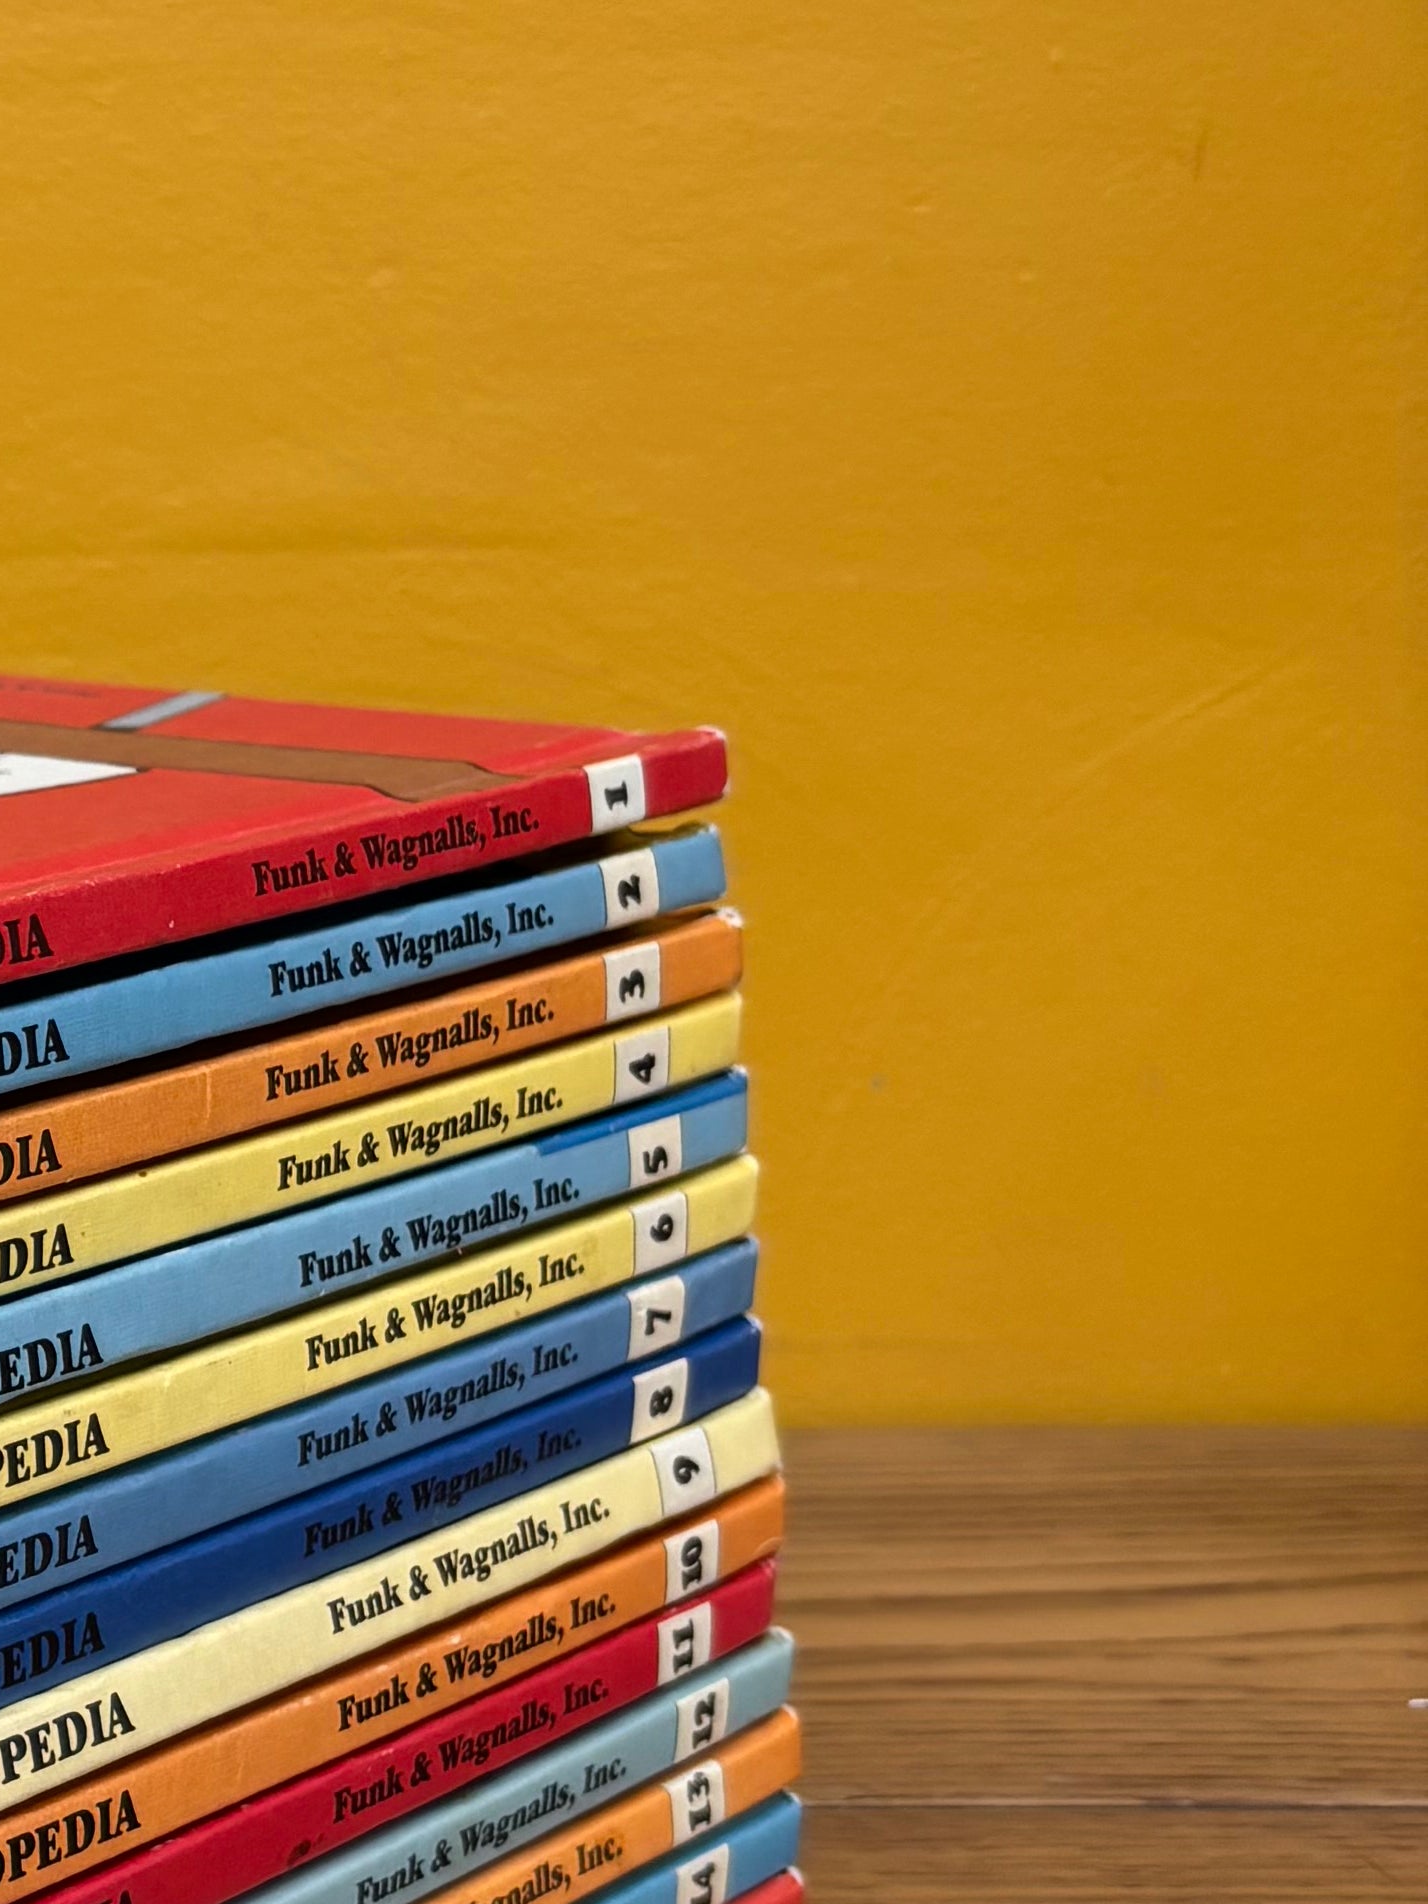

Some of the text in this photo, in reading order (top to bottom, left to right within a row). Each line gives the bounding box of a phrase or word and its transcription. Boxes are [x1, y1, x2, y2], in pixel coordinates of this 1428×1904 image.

[604, 781, 628, 809] 1
[252, 806, 538, 895] Funk & Wagnalls, Inc.
[617, 874, 641, 908] 2
[269, 903, 553, 996] Funk & Wagnalls, Inc.
[619, 969, 645, 1002] 3
[265, 999, 553, 1100] Funk & Wagnalls, Inc.
[628, 1053, 656, 1084] 4
[278, 1087, 562, 1190] Funk & Wagnalls, Inc.
[643, 1146, 668, 1174] 5
[299, 1177, 580, 1287] Funk & Wagnalls, Inc.
[650, 1213, 674, 1242] 6
[305, 1254, 584, 1370] Funk & Wagnalls, Inc.
[645, 1309, 672, 1335] 7
[299, 1343, 577, 1466] Funk & Wagnalls, Inc.
[649, 1386, 673, 1417] 8
[304, 1429, 580, 1557] Funk & Wagnalls, Inc.
[673, 1456, 700, 1484] 9
[327, 1499, 609, 1633] Funk & Wagnalls, Inc.
[681, 1537, 703, 1589] 10
[338, 1594, 615, 1730] Funk & Wagnalls, Inc.
[673, 1620, 694, 1673] 11
[692, 1693, 715, 1748] 12
[333, 1680, 607, 1822] Funk & Wagnalls, Inc.
[431, 1839, 451, 1872] &
[460, 1782, 575, 1855] Wagnalls,
[583, 1759, 625, 1793] Inc.
[688, 1776, 711, 1830] 13
[577, 1839, 622, 1874] Inc.
